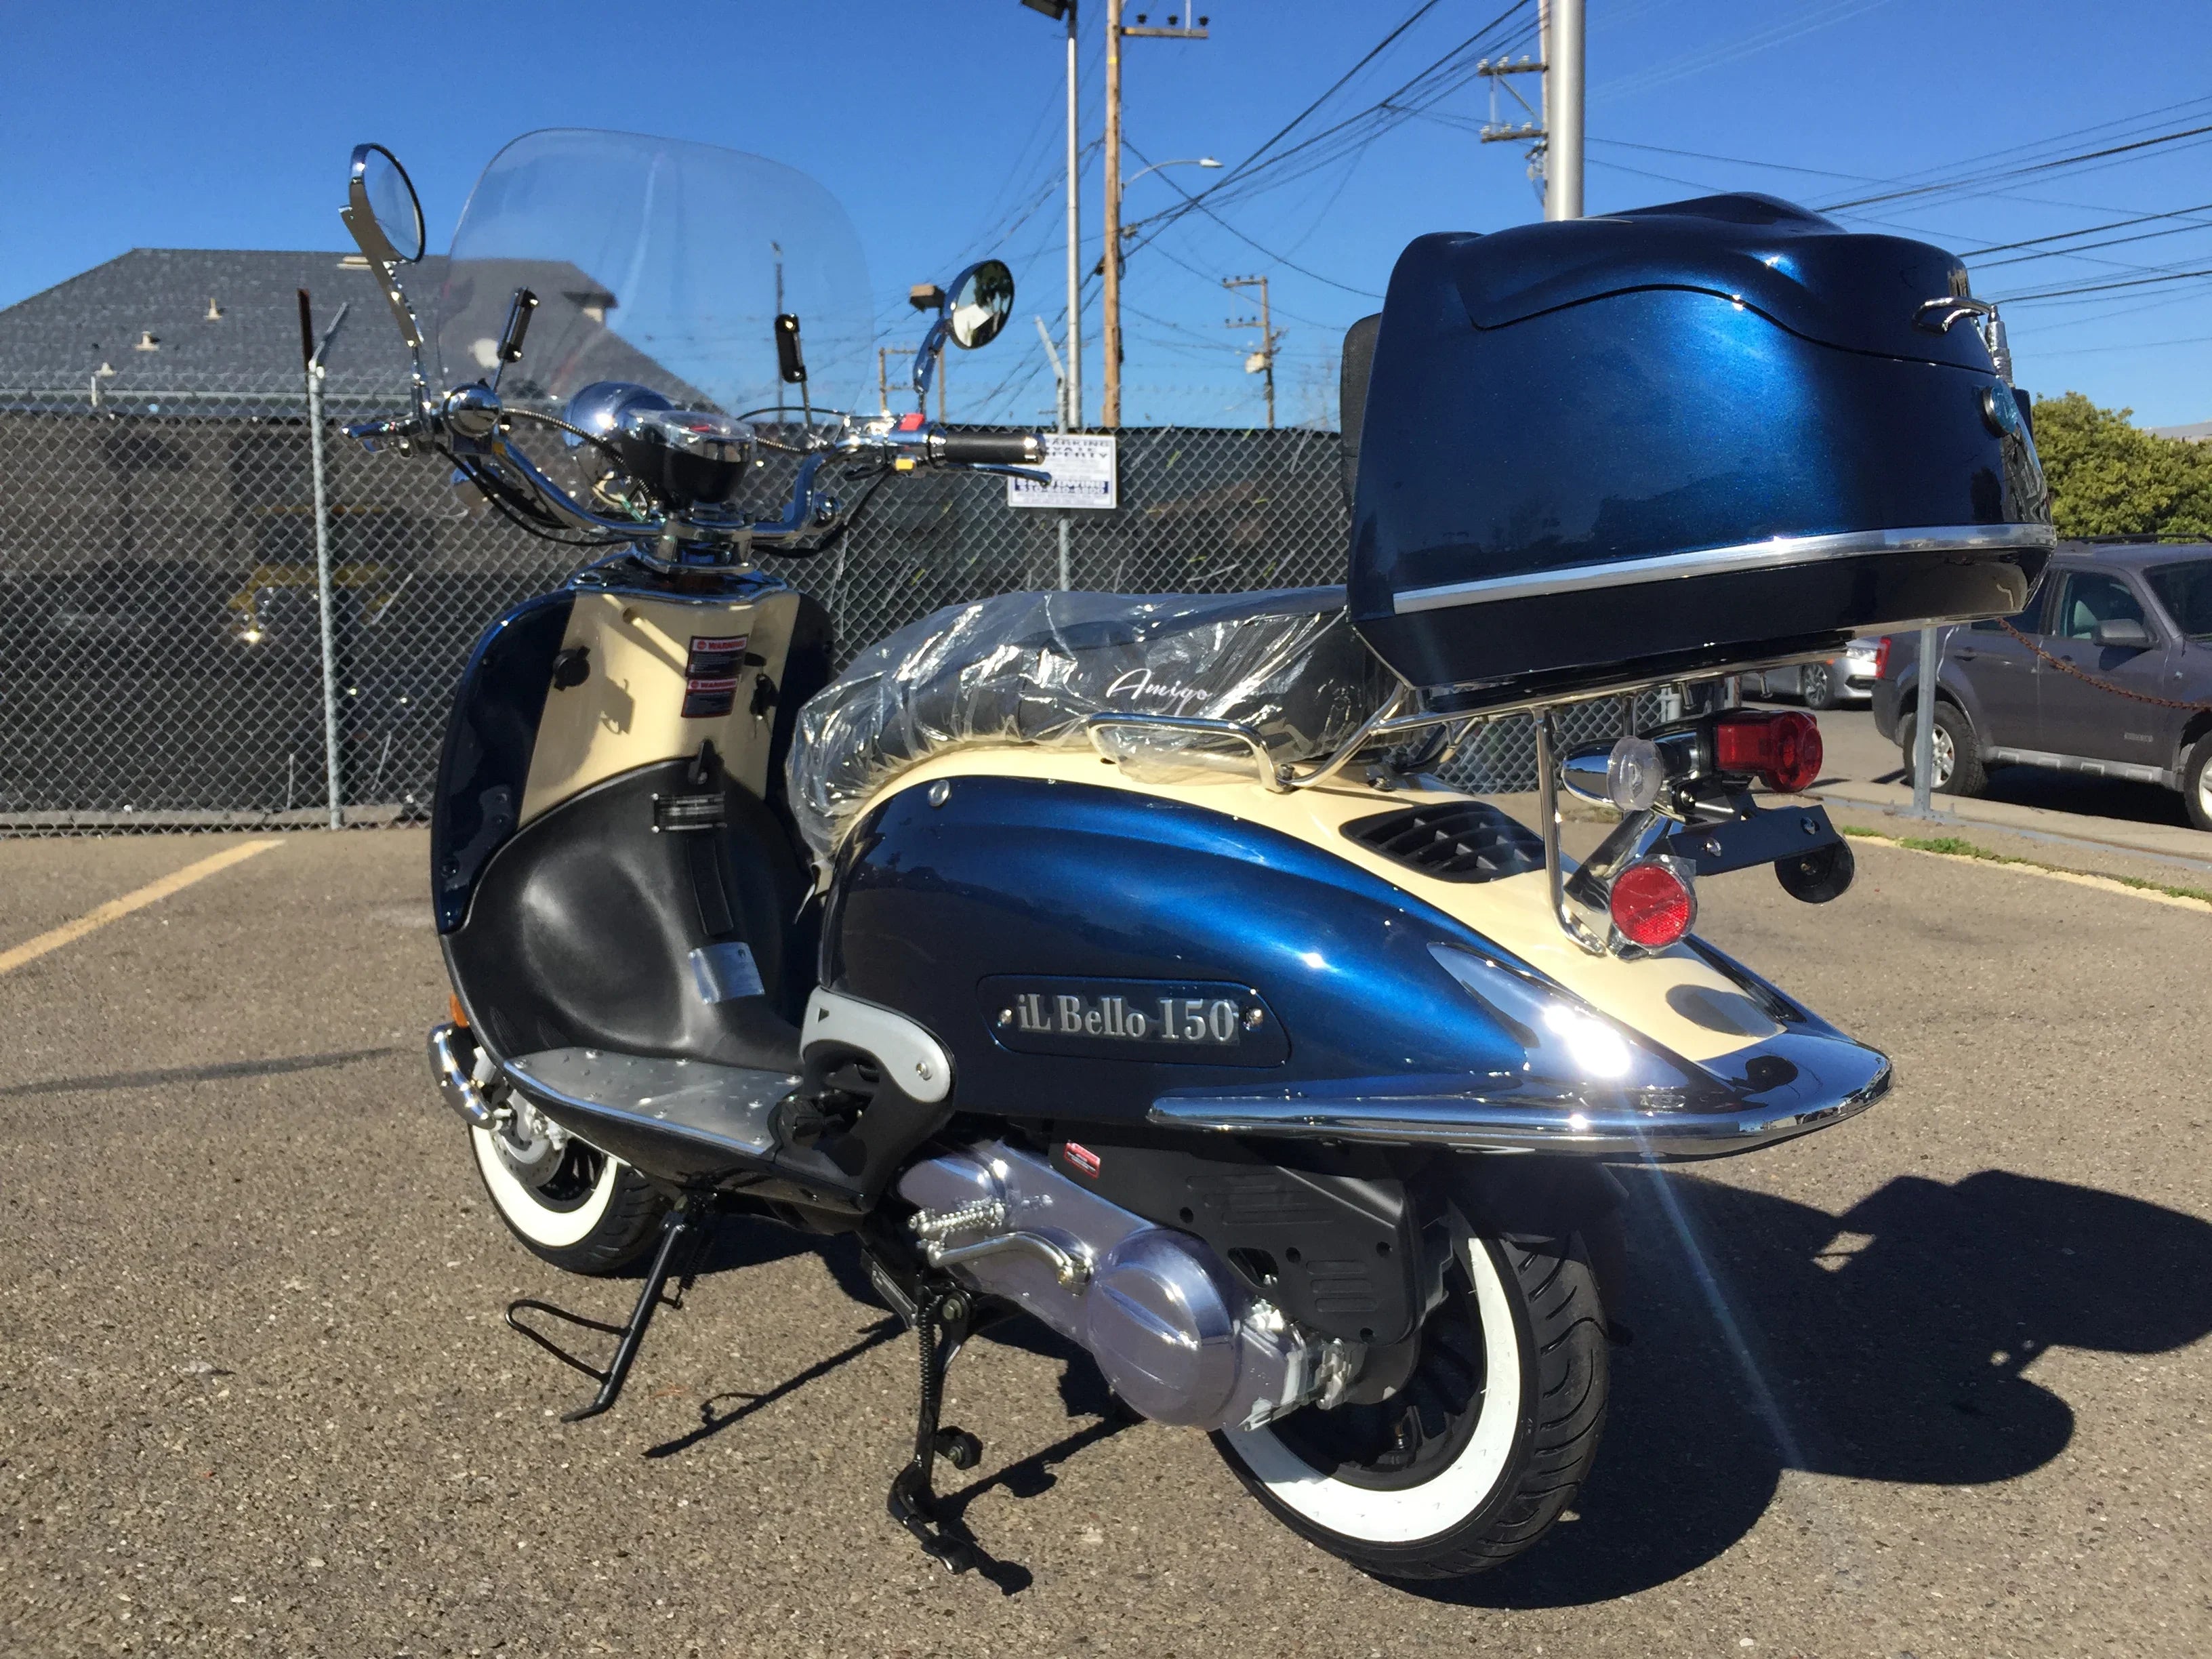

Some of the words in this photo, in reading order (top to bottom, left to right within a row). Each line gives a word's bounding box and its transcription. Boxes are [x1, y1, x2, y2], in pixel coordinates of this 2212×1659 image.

[1105, 668, 1212, 716] Amigo
[1018, 994, 1051, 1031] iL
[1057, 995, 1147, 1038] Bello
[1160, 998, 1235, 1042] 150
